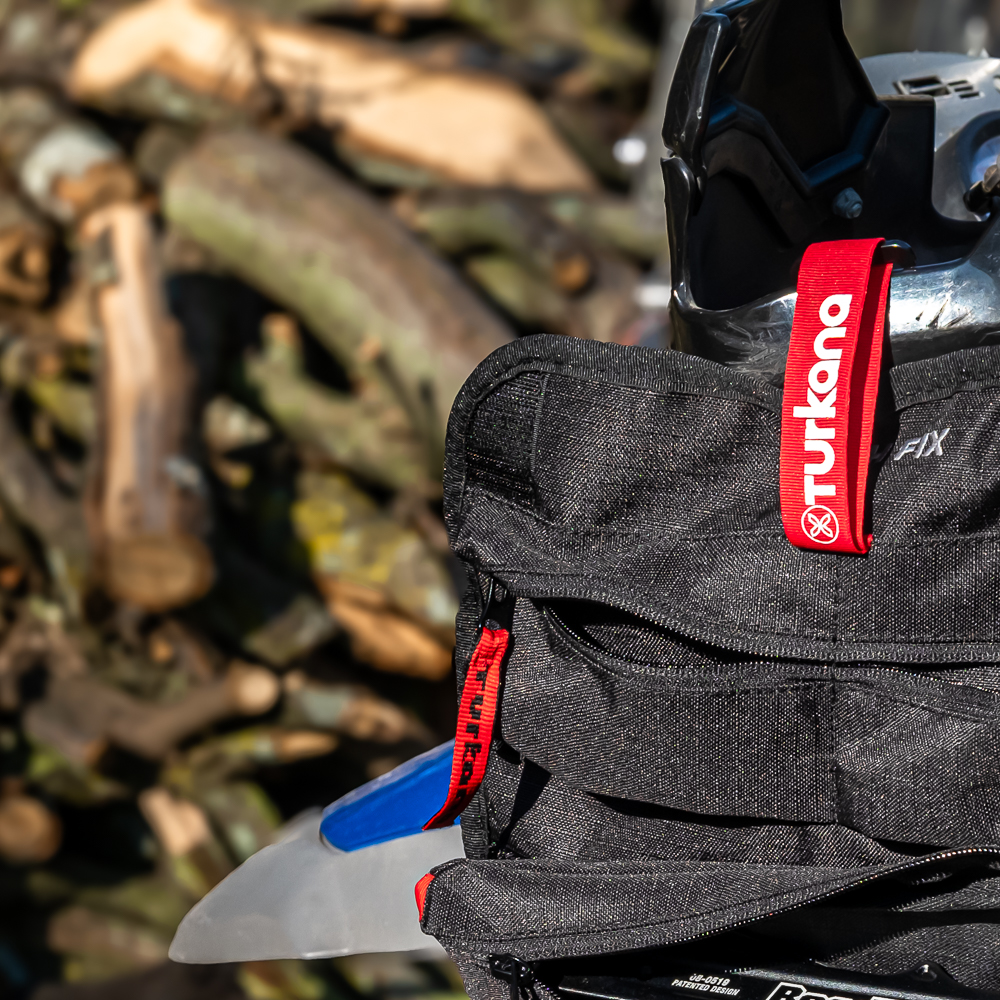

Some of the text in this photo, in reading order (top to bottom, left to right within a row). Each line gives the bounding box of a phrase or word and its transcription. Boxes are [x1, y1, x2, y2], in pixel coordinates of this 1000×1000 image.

[894, 428, 950, 460] FIX
[671, 979, 741, 996] PATENTED DESIGN
